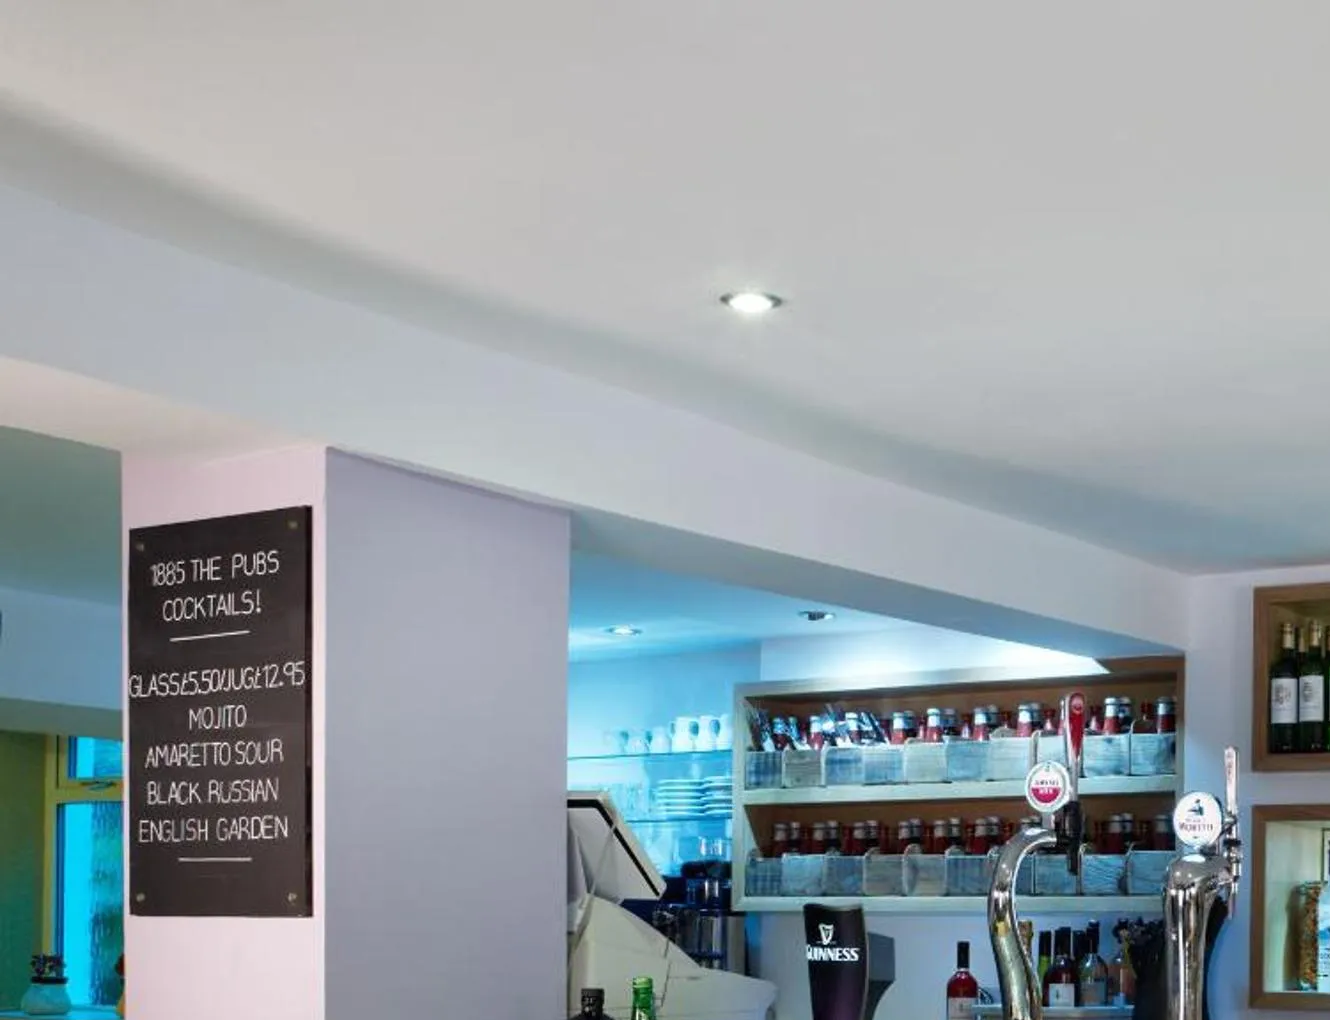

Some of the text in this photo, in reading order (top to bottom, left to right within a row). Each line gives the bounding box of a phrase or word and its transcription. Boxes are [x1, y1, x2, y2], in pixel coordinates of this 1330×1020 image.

[150, 549, 280, 587] 1885 THE PUBS
[162, 588, 262, 622] COCKTAILS!
[188, 704, 248, 731] MOJITO
[144, 738, 285, 769] AMARETTO SOUR
[147, 777, 280, 806] BLACK RUSSIAN
[138, 814, 289, 844] ENGLISH GARDEN
[806, 945, 861, 962] GUINNESS
